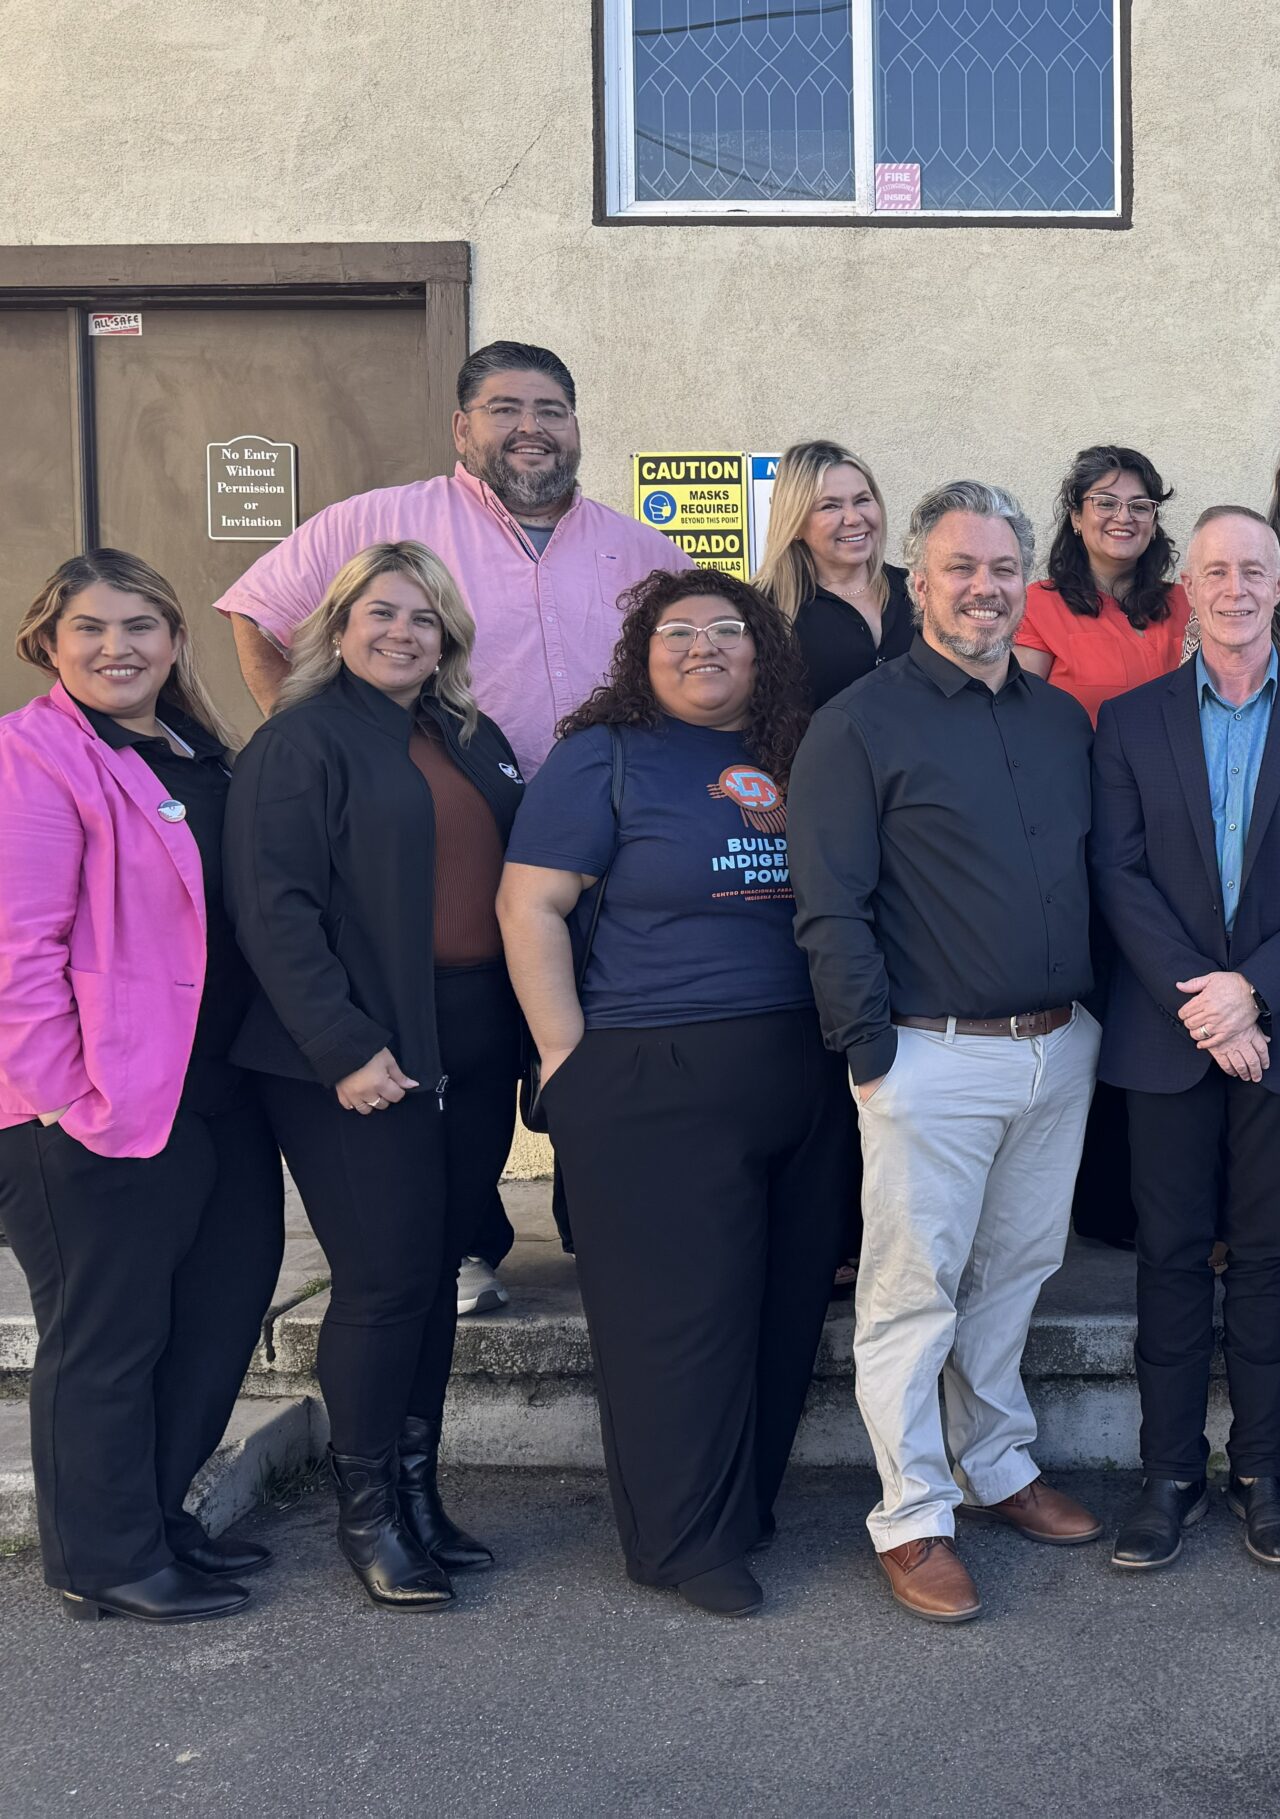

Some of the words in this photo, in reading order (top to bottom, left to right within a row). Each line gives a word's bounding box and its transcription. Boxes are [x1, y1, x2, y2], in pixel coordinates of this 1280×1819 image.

[884, 172, 911, 182] FIRE
[883, 193, 913, 201] INSIDE
[221, 448, 240, 460] No
[244, 448, 279, 463] Entry
[226, 465, 276, 477] Without
[642, 461, 739, 480] CAUTION
[217, 481, 285, 494] Permission
[689, 490, 730, 501] MASKS
[243, 501, 259, 510] or
[680, 503, 739, 514] REQUIRED
[221, 515, 282, 527] Invitation
[680, 517, 705, 525] BEYOND
[706, 516, 720, 524] THIS
[721, 516, 739, 524] POINT
[669, 534, 740, 554] IDADO
[695, 561, 741, 571] SCARILLAS
[727, 837, 788, 853] BUILD
[712, 853, 789, 871] INDIGE
[745, 869, 790, 884] POW
